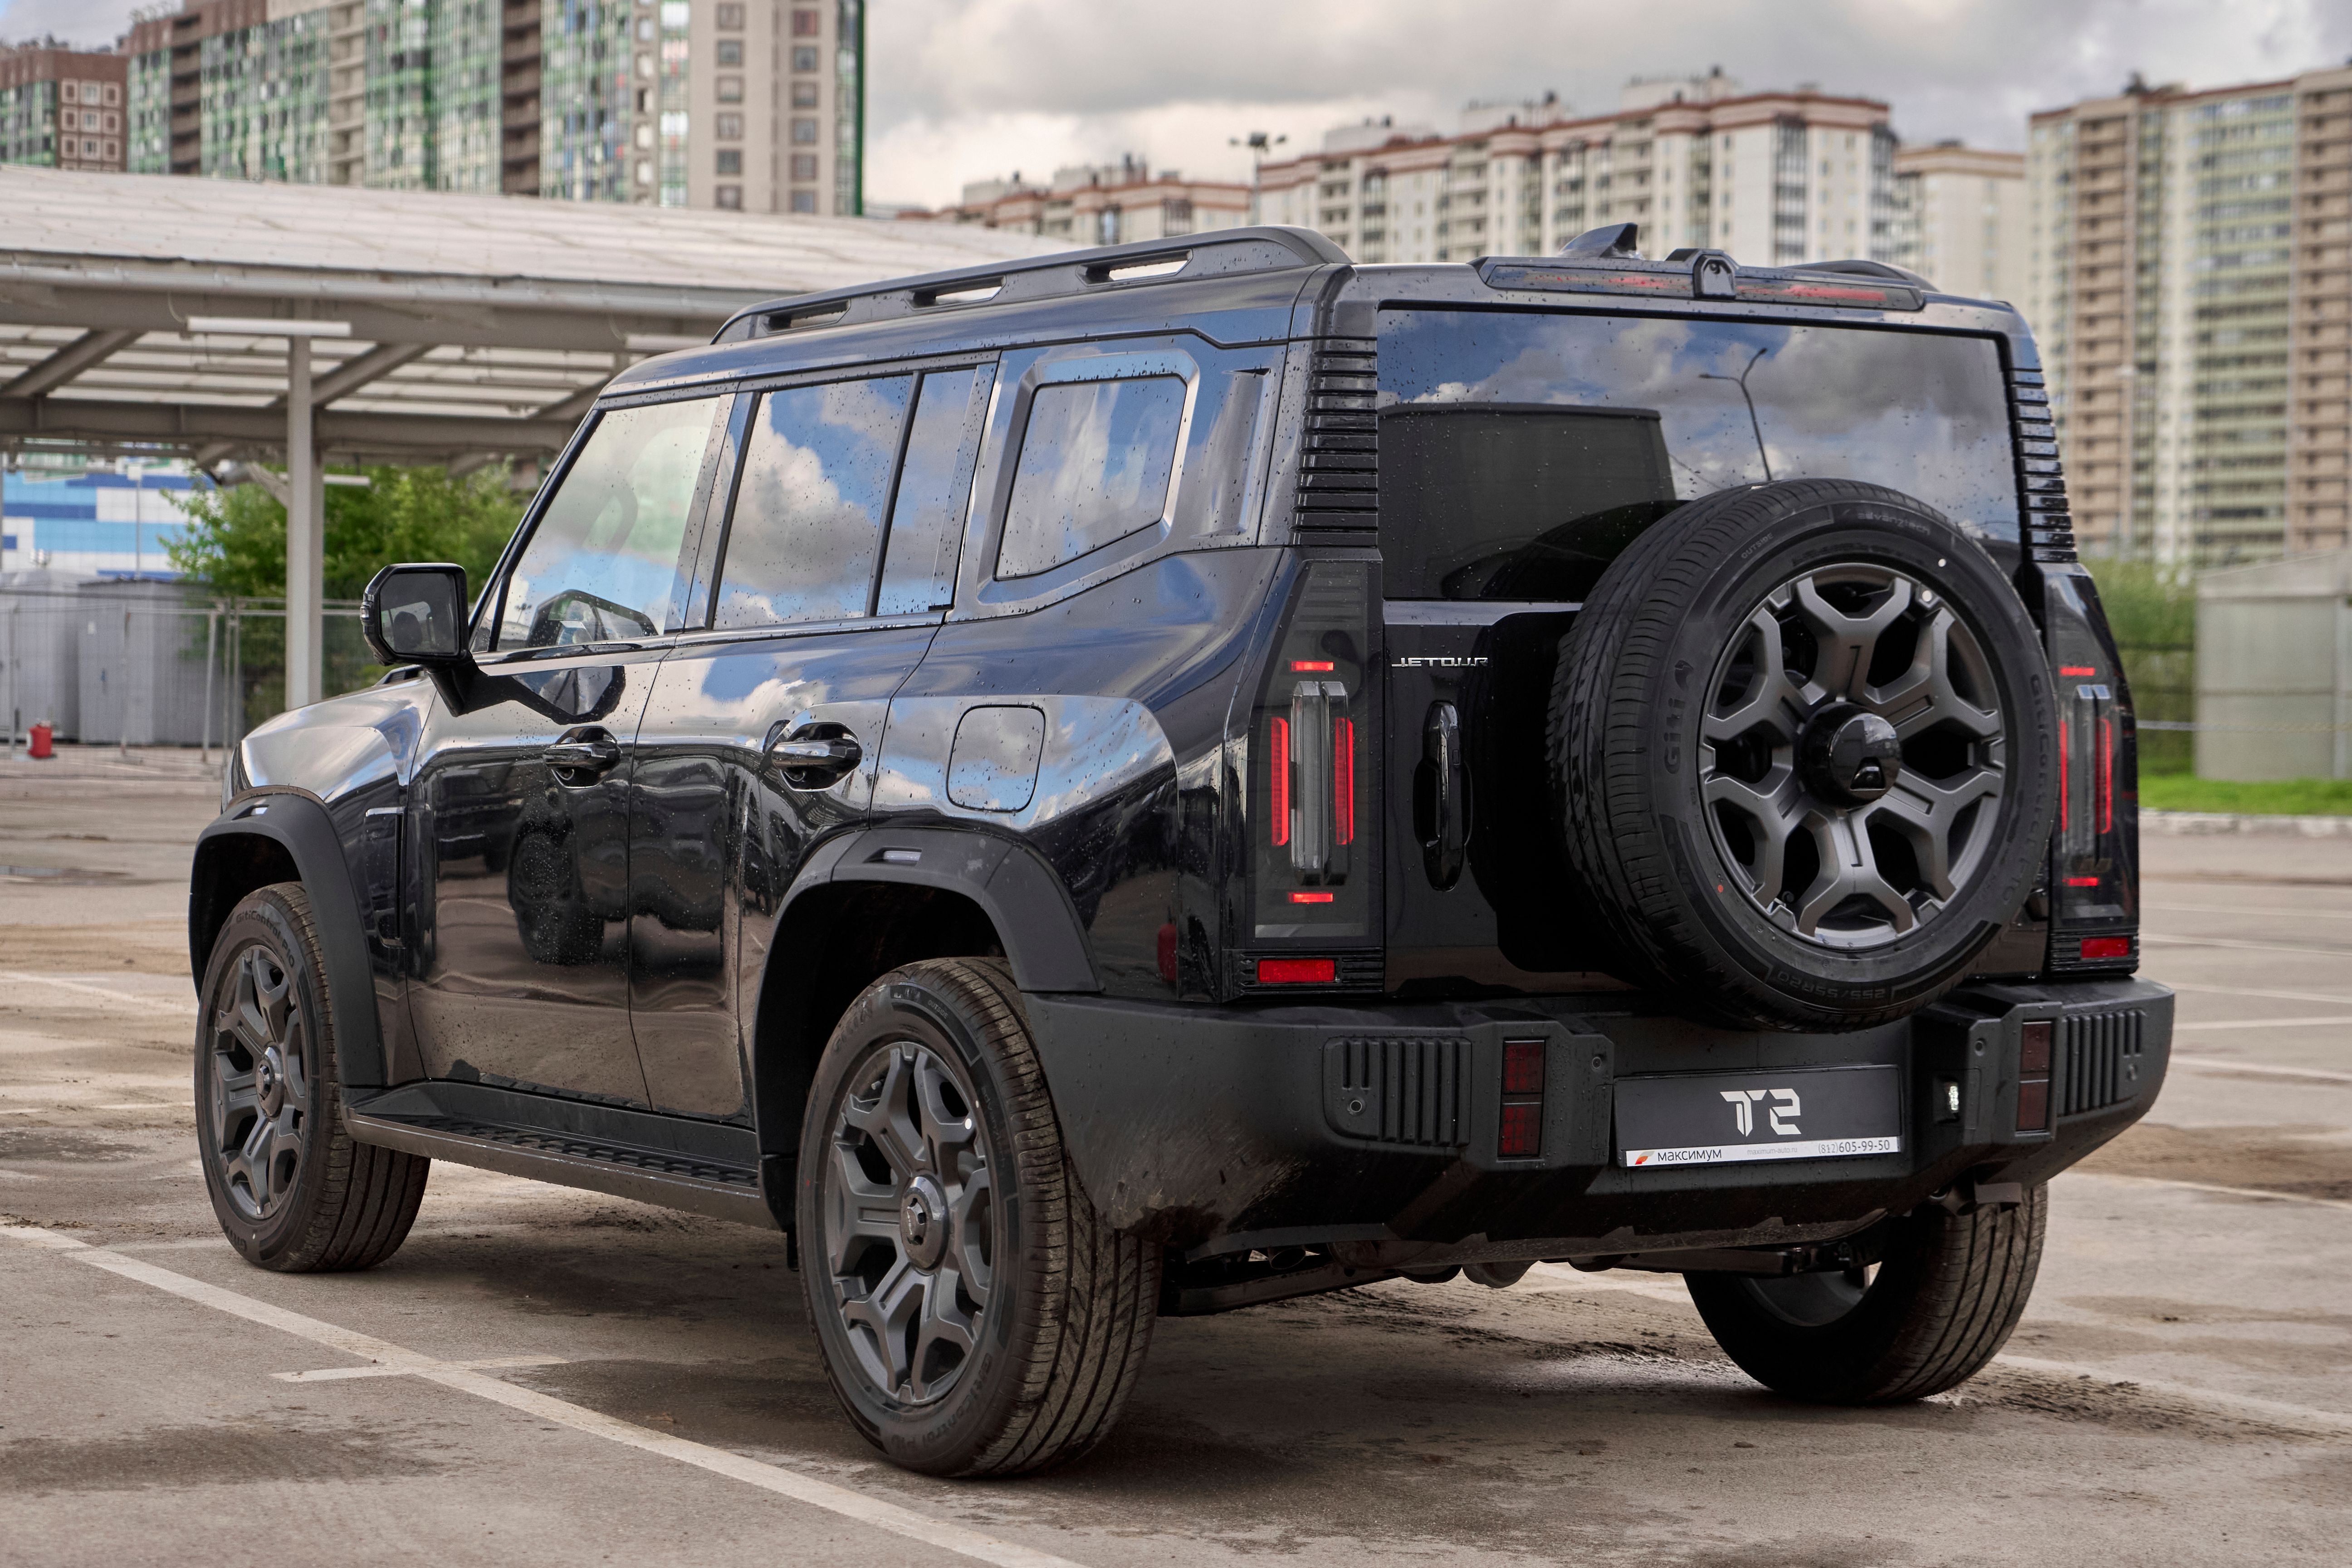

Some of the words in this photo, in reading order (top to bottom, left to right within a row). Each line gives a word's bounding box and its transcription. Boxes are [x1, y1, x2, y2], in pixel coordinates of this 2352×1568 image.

[1741, 532, 1774, 559] OUTSIDE
[1391, 657, 1488, 667] JETOUR
[1663, 697, 1686, 774] Giti
[235, 909, 282, 940] GitiControl
[1777, 971, 1886, 1000] 255/55R20
[927, 999, 949, 1020] OUTSIDE
[1720, 1088, 1802, 1137] T2
[1657, 1149, 1722, 1162] максимум
[1747, 1147, 1798, 1156] maximum-auto.ru
